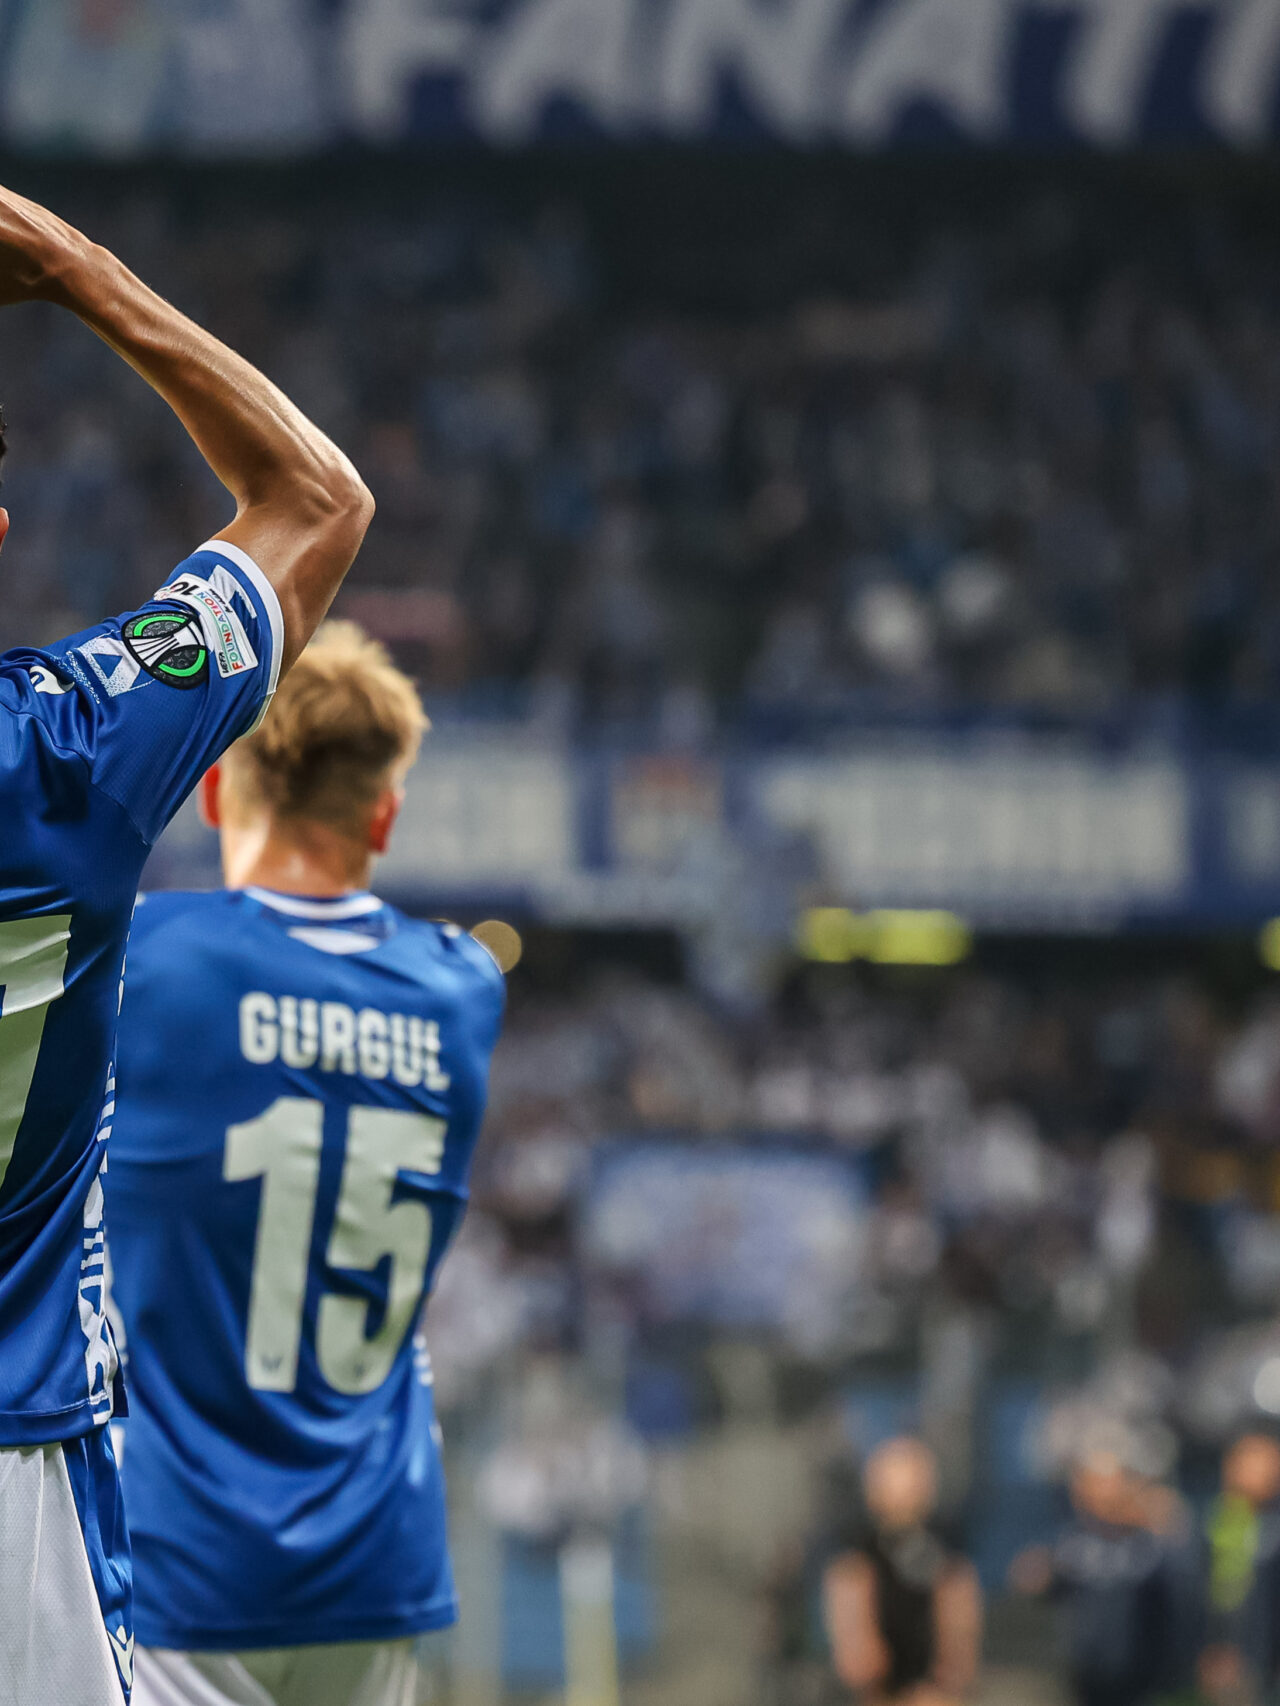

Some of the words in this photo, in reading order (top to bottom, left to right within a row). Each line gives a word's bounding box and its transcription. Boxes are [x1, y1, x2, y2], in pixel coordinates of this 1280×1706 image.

[196, 591, 244, 670] FOUNDATION
[218, 650, 229, 674] UEFA
[238, 991, 450, 1091] GURGUL
[223, 1096, 448, 1396] 15
